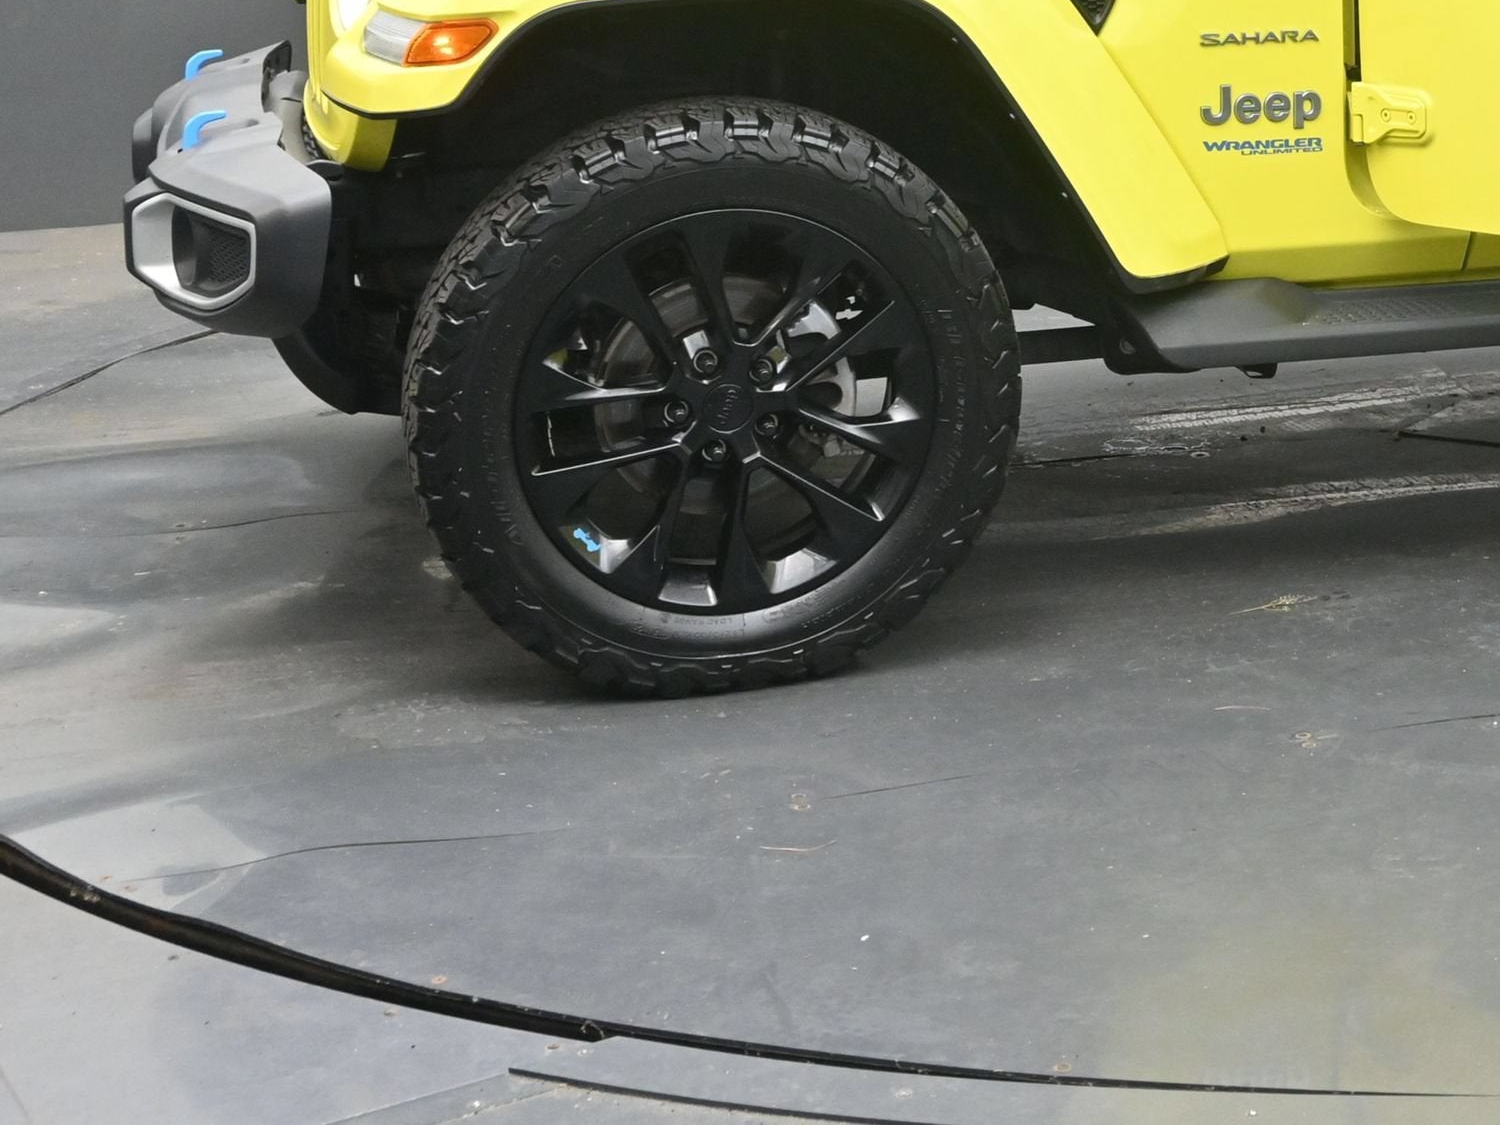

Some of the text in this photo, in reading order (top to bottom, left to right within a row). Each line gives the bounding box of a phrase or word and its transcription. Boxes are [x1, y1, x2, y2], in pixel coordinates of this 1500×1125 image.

[1199, 30, 1319, 47] SAHARA
[1199, 83, 1322, 130] Jeep
[1203, 137, 1322, 152] WRANGLER
[1241, 146, 1323, 156] UNLIMITED
